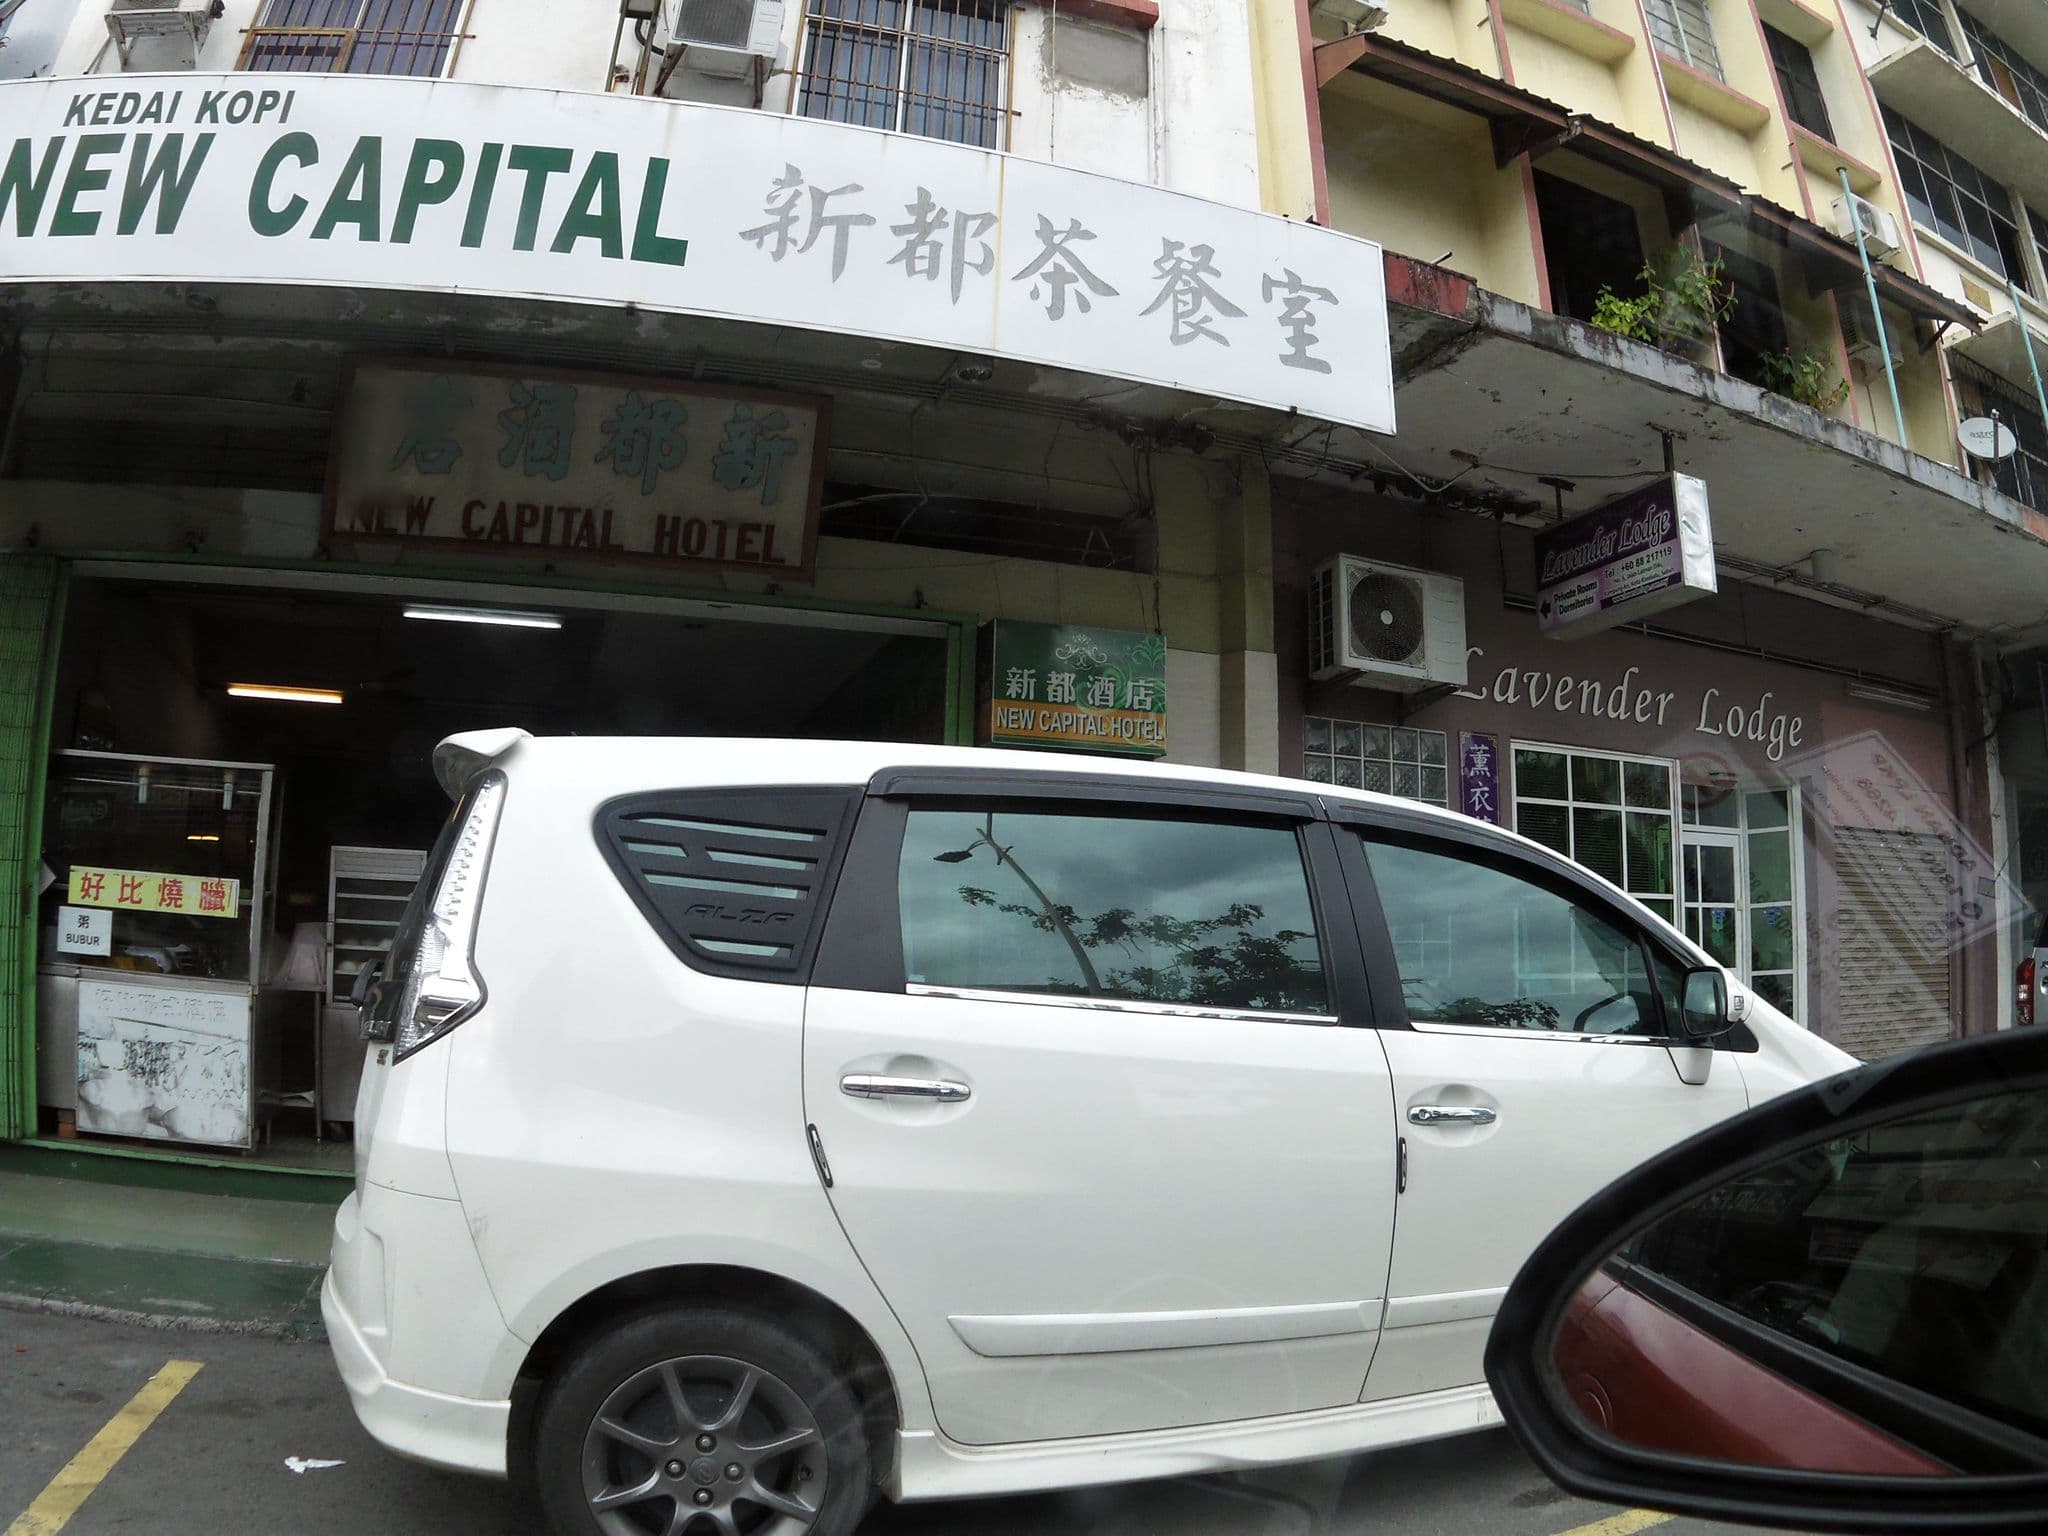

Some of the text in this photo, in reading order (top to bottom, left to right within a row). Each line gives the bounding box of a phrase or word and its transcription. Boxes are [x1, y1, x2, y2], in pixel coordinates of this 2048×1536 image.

[63, 89, 296, 128] KEDAI KOPI
[0, 130, 690, 268] NEW CAPITAL
[738, 161, 1341, 375] 新都茶餐室
[461, 498, 625, 553] CAPITAL
[654, 512, 787, 565] HOTEL
[1541, 504, 1671, 583] Lavender Lodge
[1553, 584, 1577, 603] Private
[1577, 580, 1598, 597] Rooms
[1005, 666, 1155, 711] 新都酒店
[1452, 646, 1803, 761] Lavender Lodge
[997, 706, 1165, 742] NEW CAPITAL HOTEL
[1468, 744, 1494, 824] 薰衣
[80, 872, 226, 912] 好比燒臘
[65, 933, 101, 946] BUBUR
[77, 914, 90, 929] 粥
